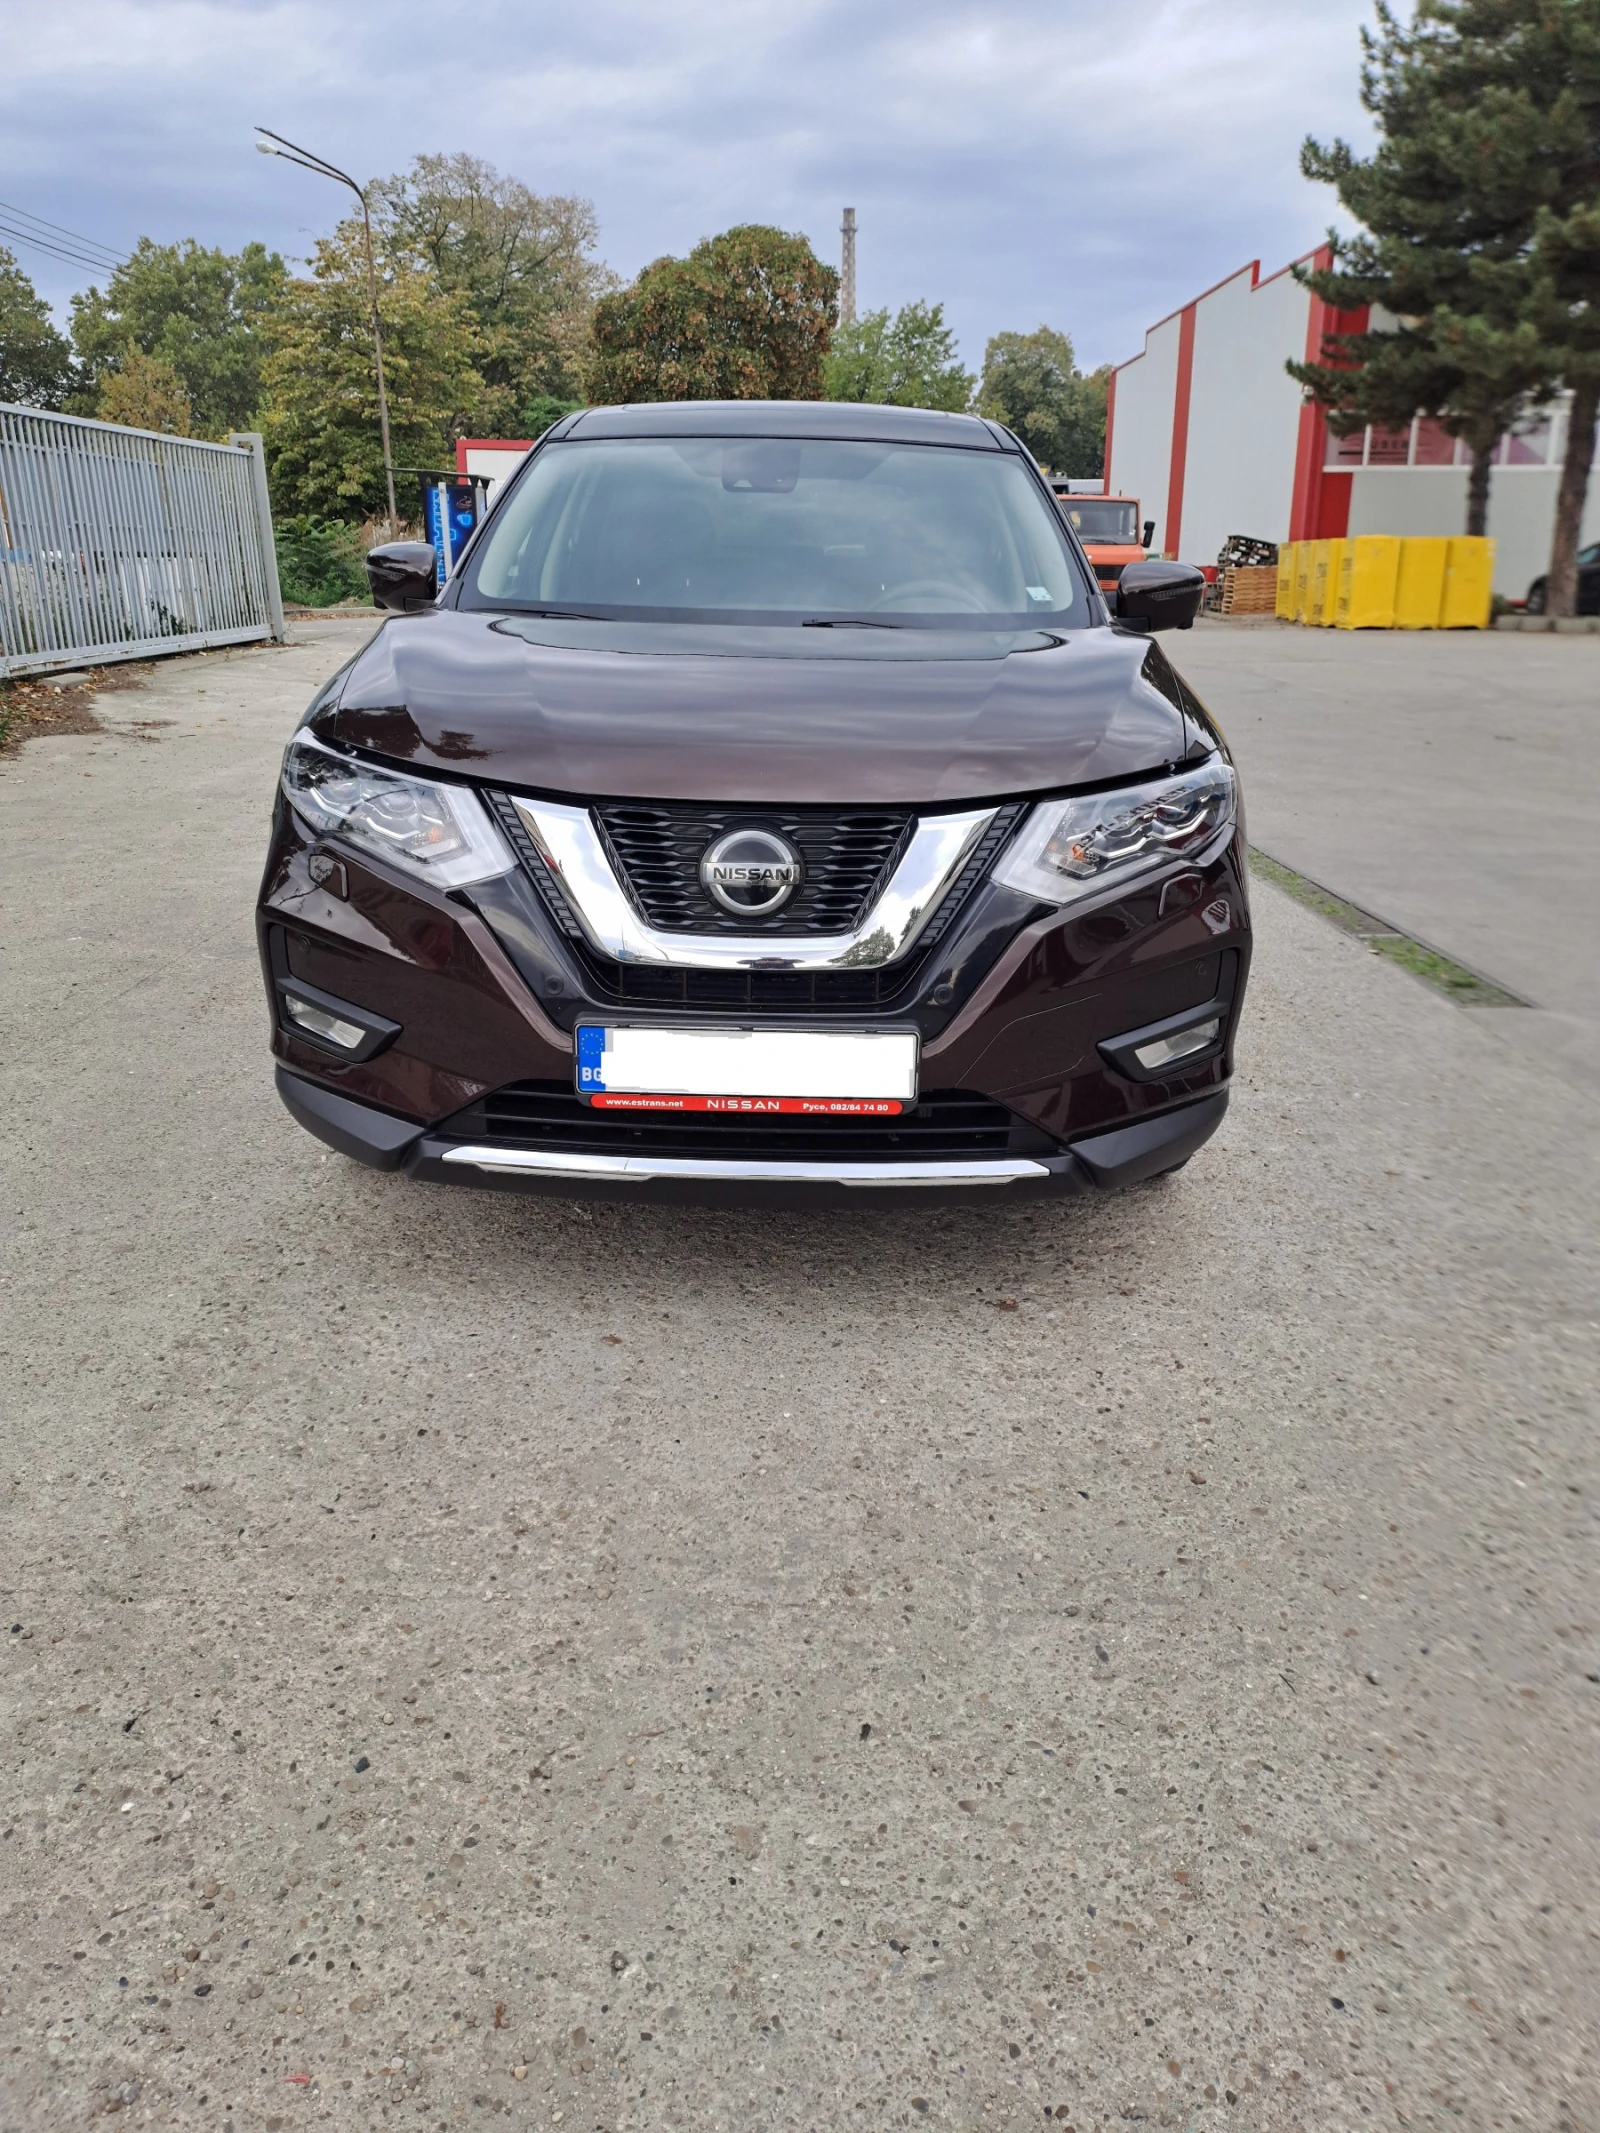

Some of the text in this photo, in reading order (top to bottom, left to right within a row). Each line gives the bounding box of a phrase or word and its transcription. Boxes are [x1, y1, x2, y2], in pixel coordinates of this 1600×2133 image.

[713, 866, 790, 881] NISSAN
[581, 1066, 602, 1082] BG
[605, 1099, 684, 1108] www.estrans.net
[707, 1099, 780, 1110] NISSAN
[830, 1103, 861, 1111] 082/84
[863, 1104, 875, 1112] 74
[876, 1104, 889, 1112] 80
